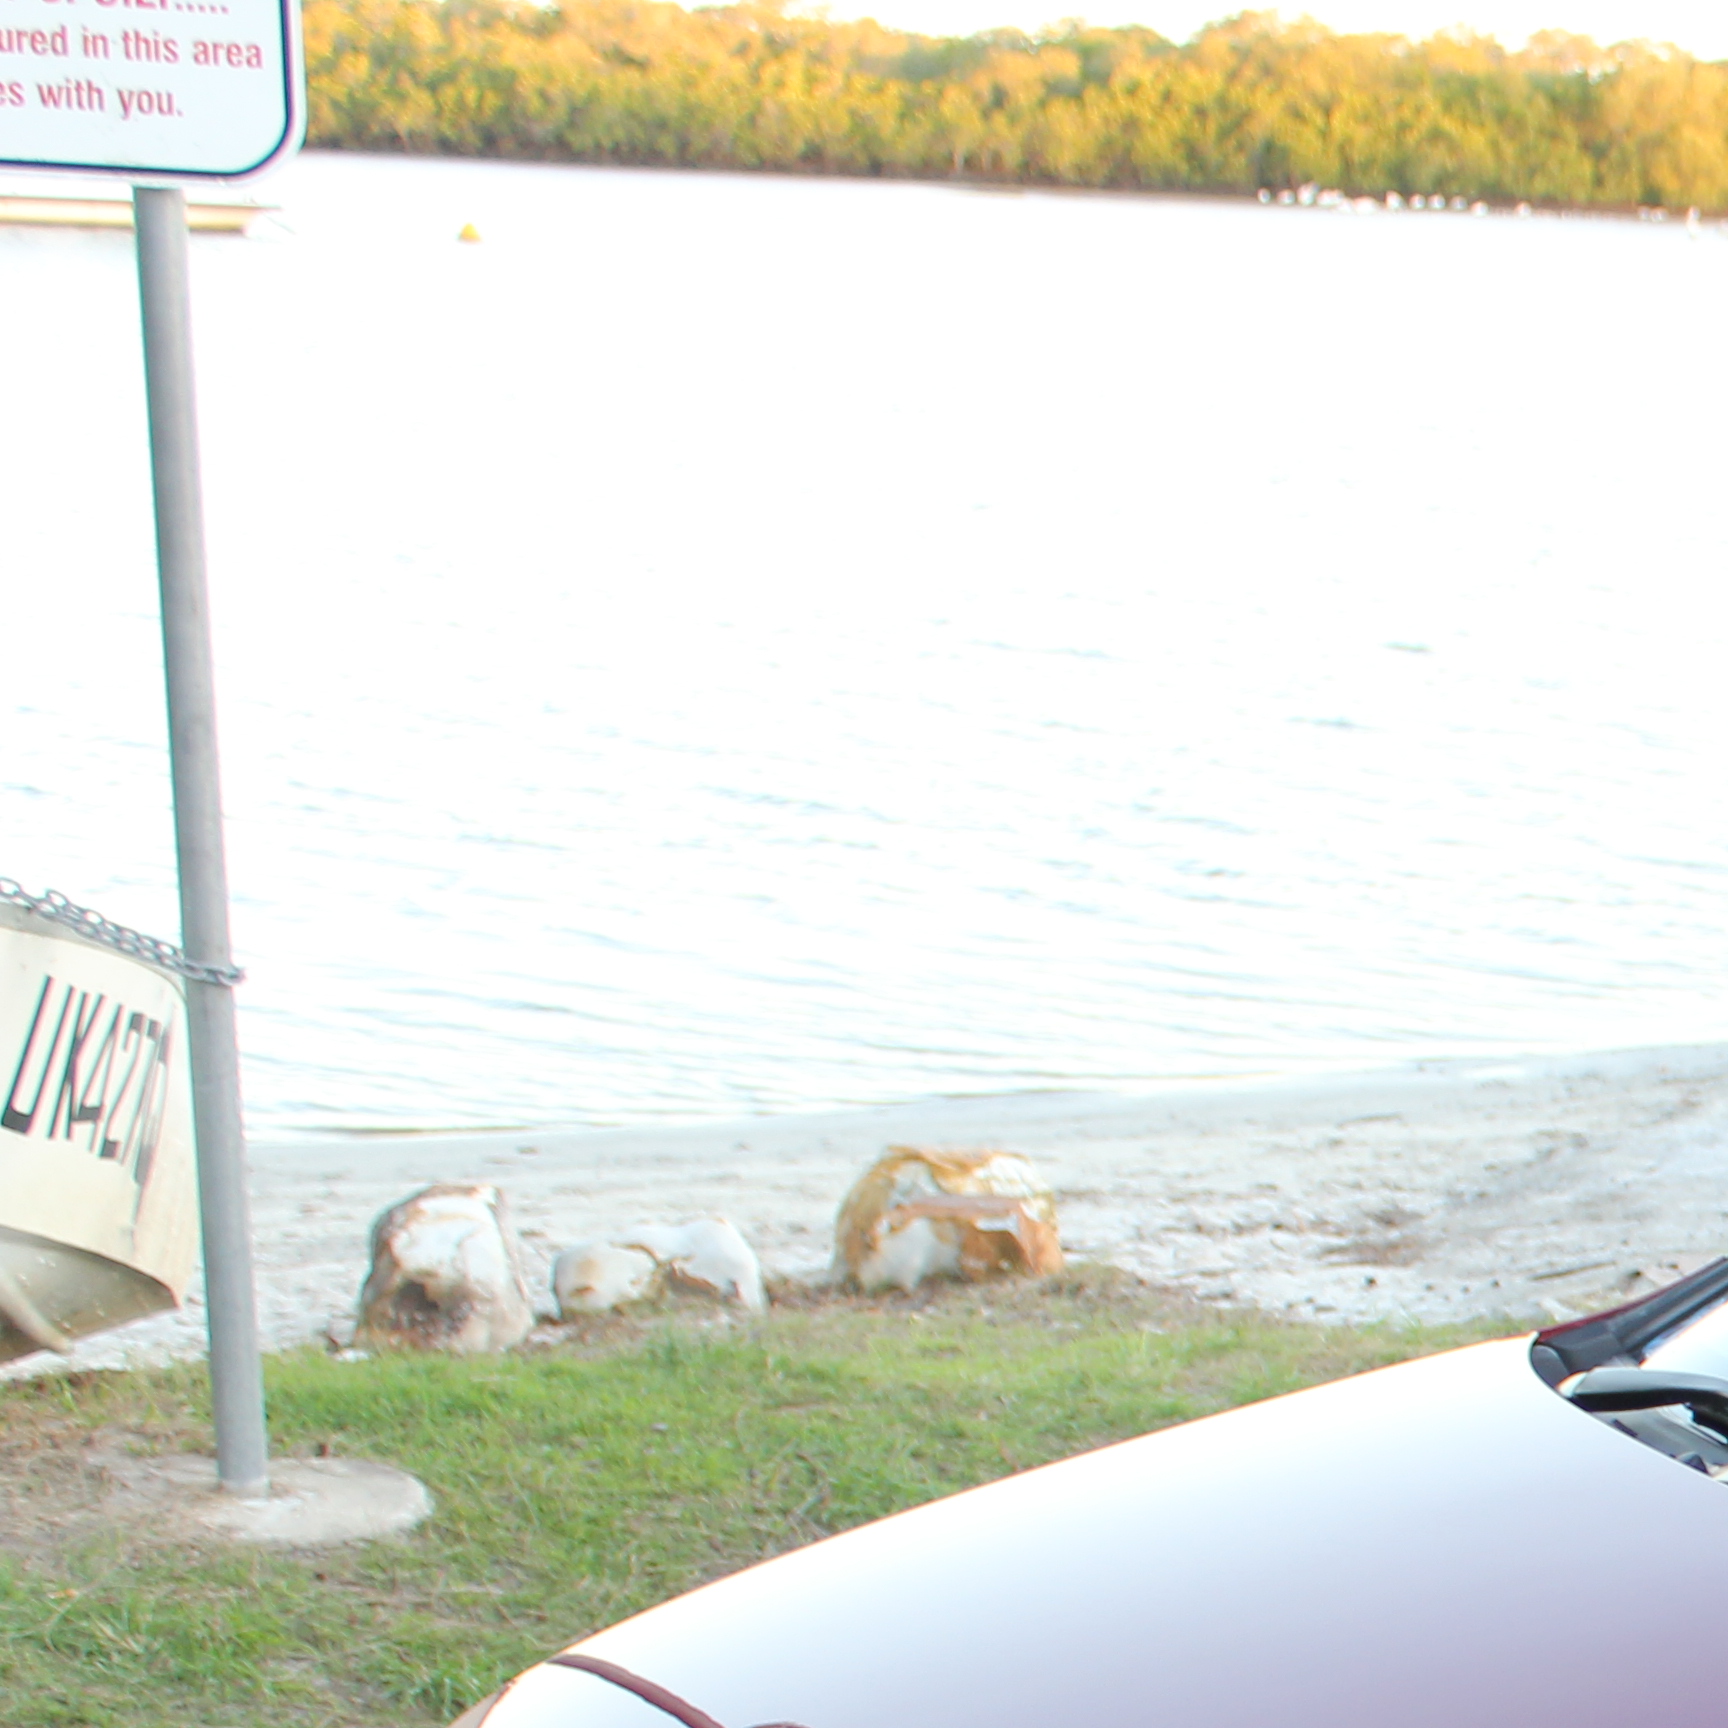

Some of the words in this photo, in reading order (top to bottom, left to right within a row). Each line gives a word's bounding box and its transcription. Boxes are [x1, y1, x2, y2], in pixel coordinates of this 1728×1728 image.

[82, 26, 110, 60] in
[121, 29, 181, 64] this
[192, 41, 264, 69] area
[36, 79, 105, 111] with
[116, 88, 184, 120] you.
